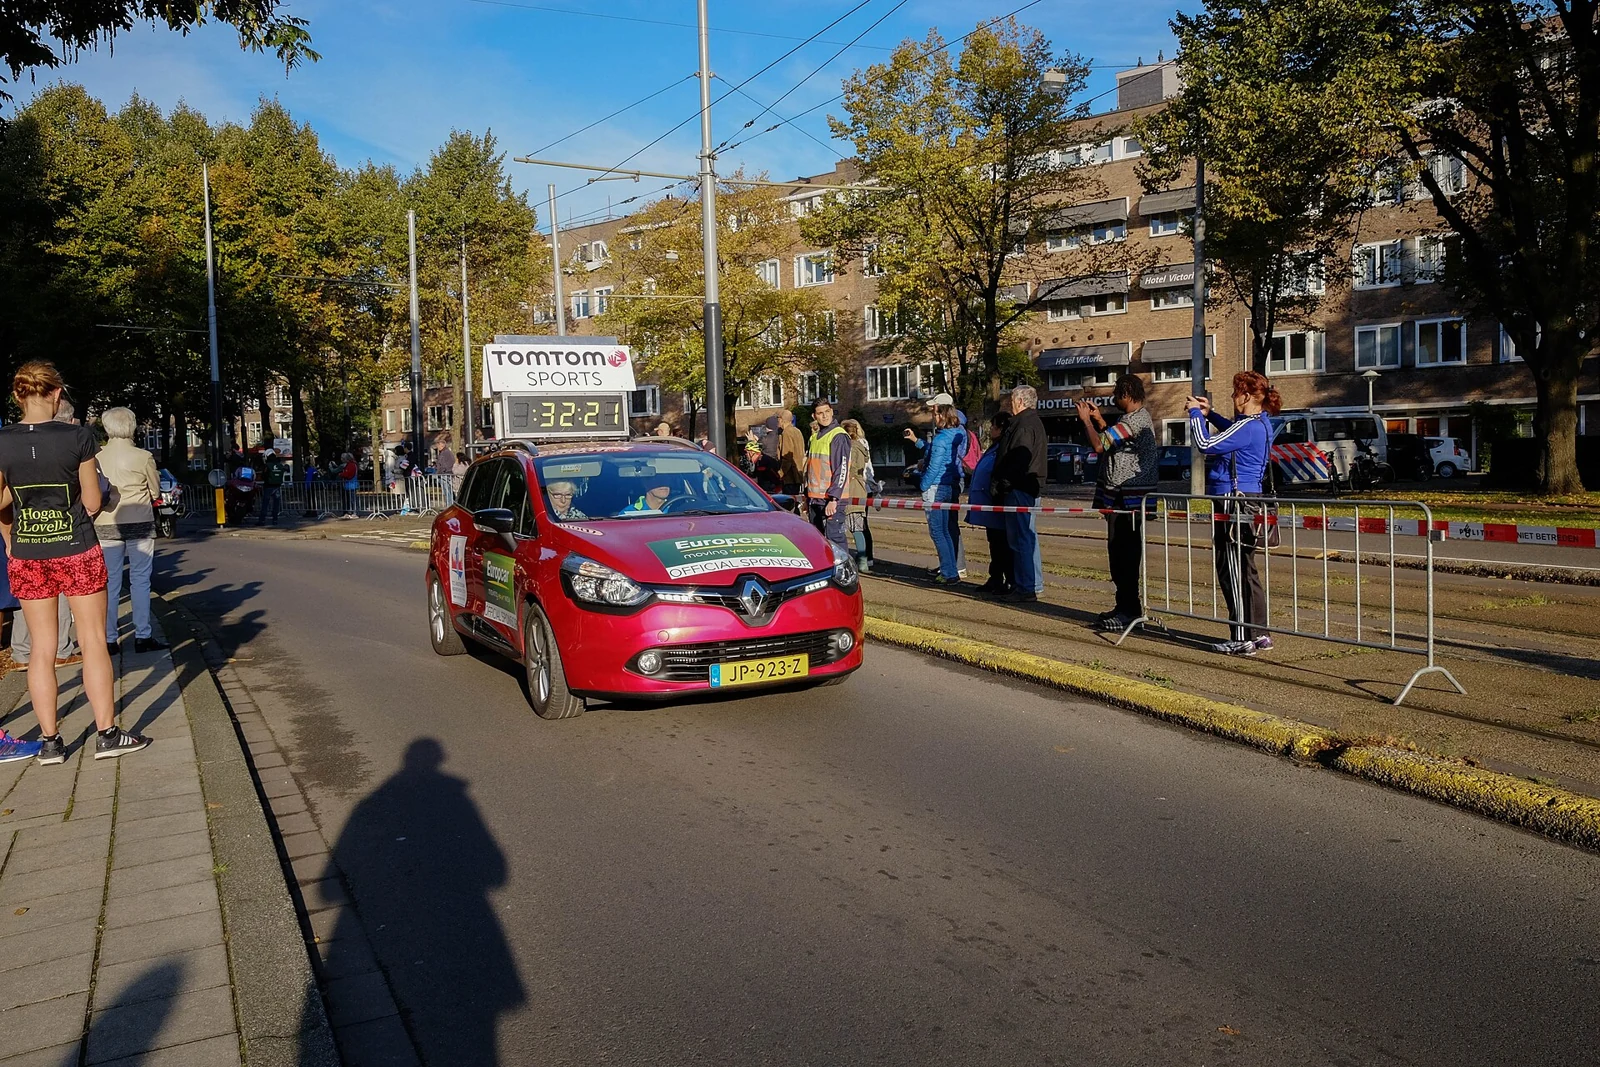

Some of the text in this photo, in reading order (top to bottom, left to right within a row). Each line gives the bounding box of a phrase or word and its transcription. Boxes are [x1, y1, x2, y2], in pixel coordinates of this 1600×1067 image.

[1145, 272, 1194, 285] Hotel Victori
[1055, 354, 1104, 366] Hotel Victorie
[527, 371, 603, 386] SPORTS
[1037, 395, 1116, 410] HOTEL VICTO
[20, 508, 64, 521] Hogan
[22, 520, 68, 533] Lovells
[1459, 525, 1579, 543] POLITIE NIET BETREDEN
[675, 536, 772, 550] Europcar
[683, 547, 784, 560] moving your way
[486, 560, 510, 583] Europcar
[670, 557, 812, 578] OFFICIAL SPONSOR
[729, 658, 801, 682] JP-923-Z
